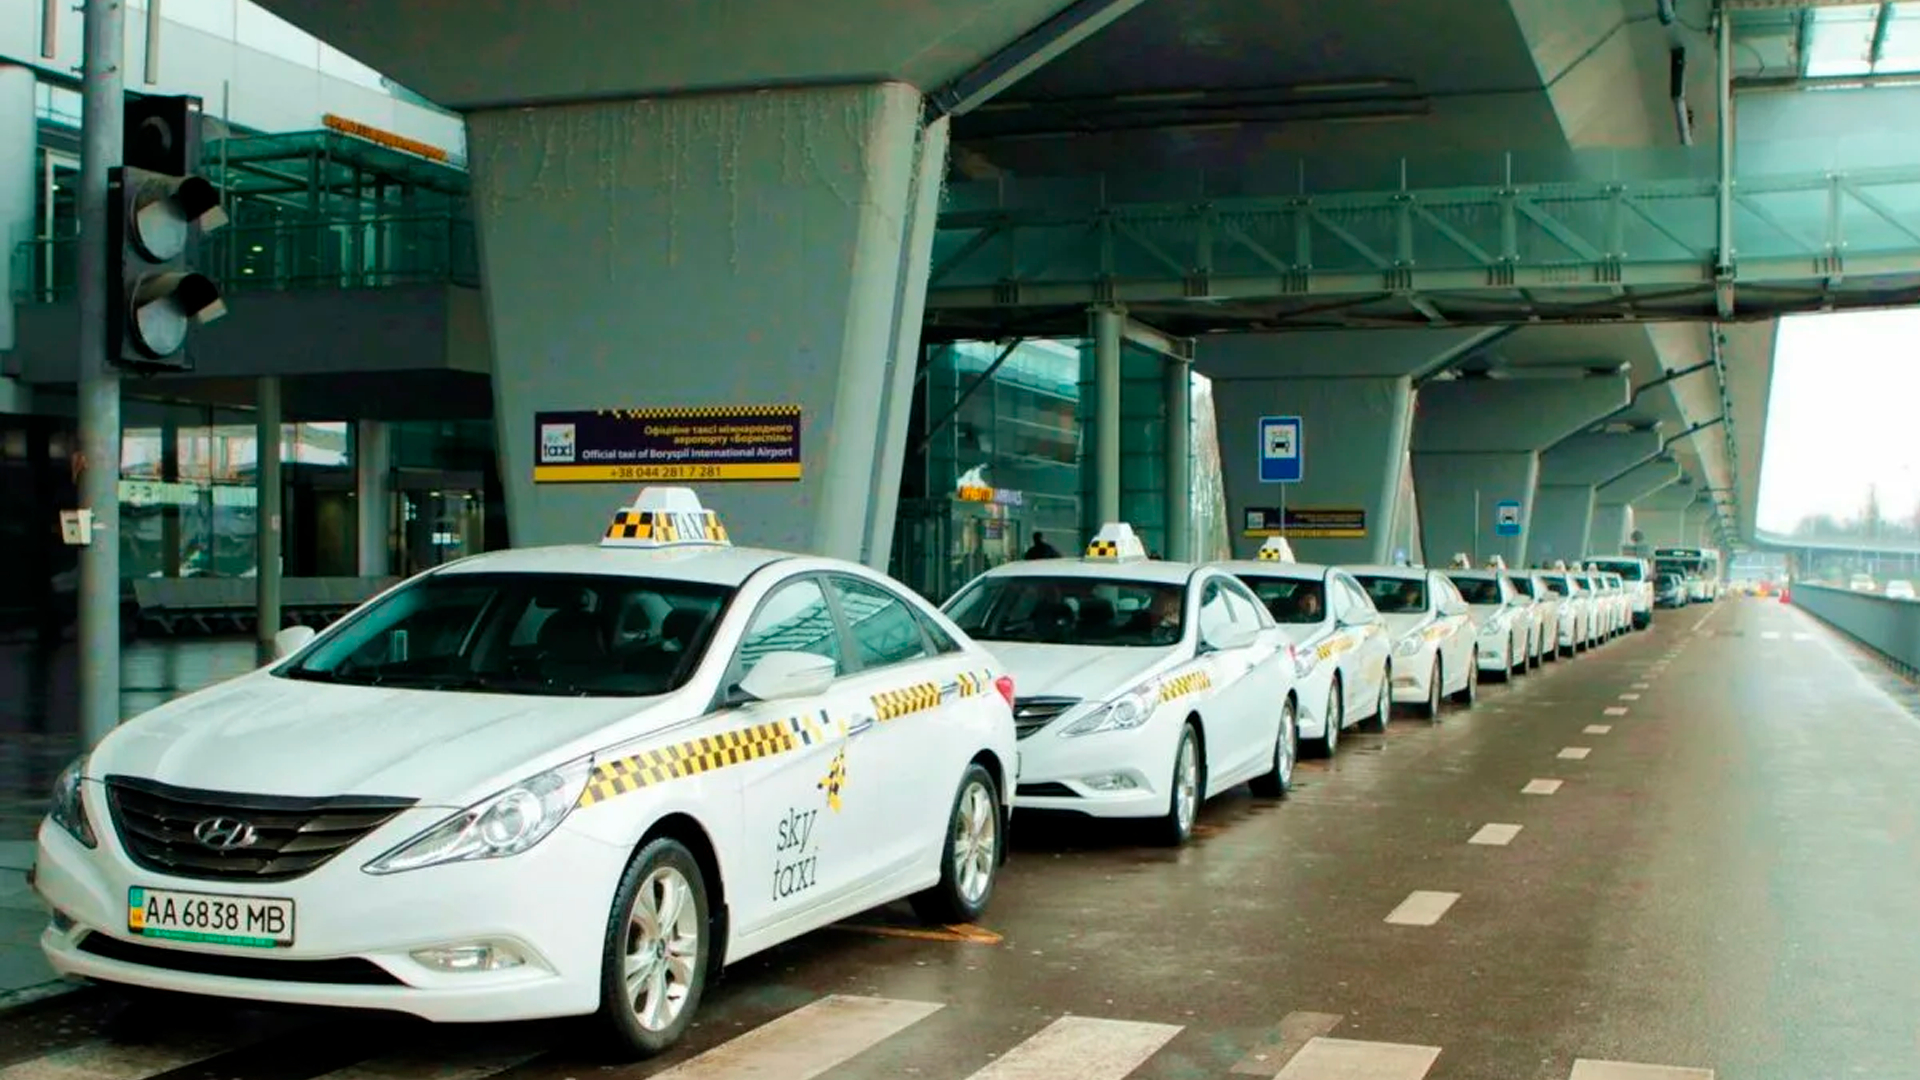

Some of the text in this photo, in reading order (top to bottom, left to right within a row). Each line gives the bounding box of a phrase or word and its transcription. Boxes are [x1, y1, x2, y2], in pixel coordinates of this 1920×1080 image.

[692, 424, 717, 434] таксі
[673, 434, 728, 446] аеропорту
[543, 443, 573, 457] taxi
[582, 446, 793, 461] Official taxi of Boryspil International Airport
[611, 466, 722, 478] +38 044 281 7 281
[776, 807, 817, 854] sky
[773, 849, 818, 901] taxi
[145, 896, 177, 926] AA
[182, 899, 239, 931] 6838
[247, 904, 286, 934] MB
